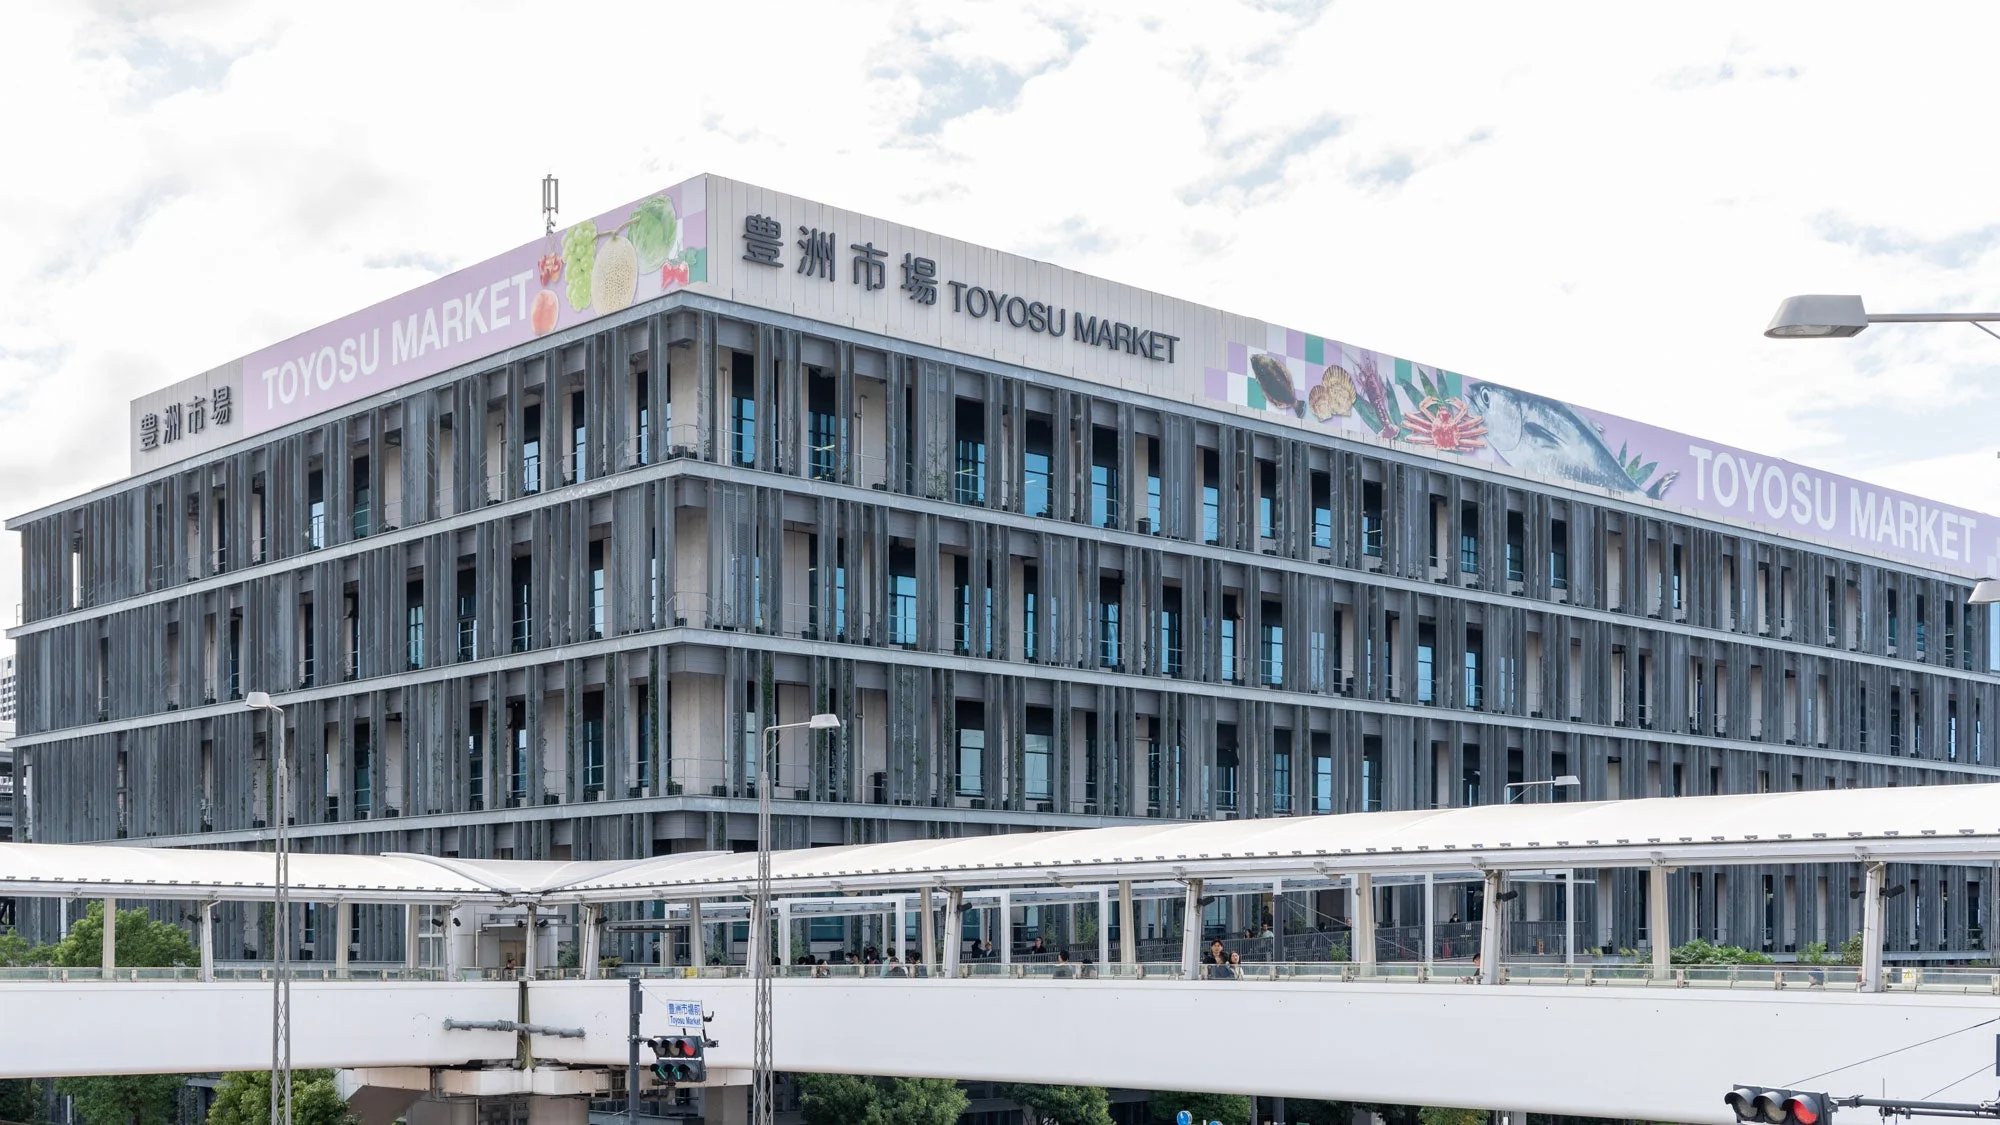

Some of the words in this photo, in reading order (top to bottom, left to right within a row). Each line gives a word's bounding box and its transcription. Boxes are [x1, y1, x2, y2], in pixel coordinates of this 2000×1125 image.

[262, 328, 380, 410] TOYOSU
[391, 269, 534, 365] MARKET
[743, 213, 938, 306] 豊洲市場
[948, 280, 1066, 337] TOYOSU
[1075, 312, 1180, 364] MARKET
[140, 385, 232, 452] 豊洲市場
[1689, 445, 1836, 531] TOYOSU
[1850, 488, 1977, 564] MARKET
[670, 1016, 685, 1025] Toyosu
[685, 1017, 701, 1025] Market
